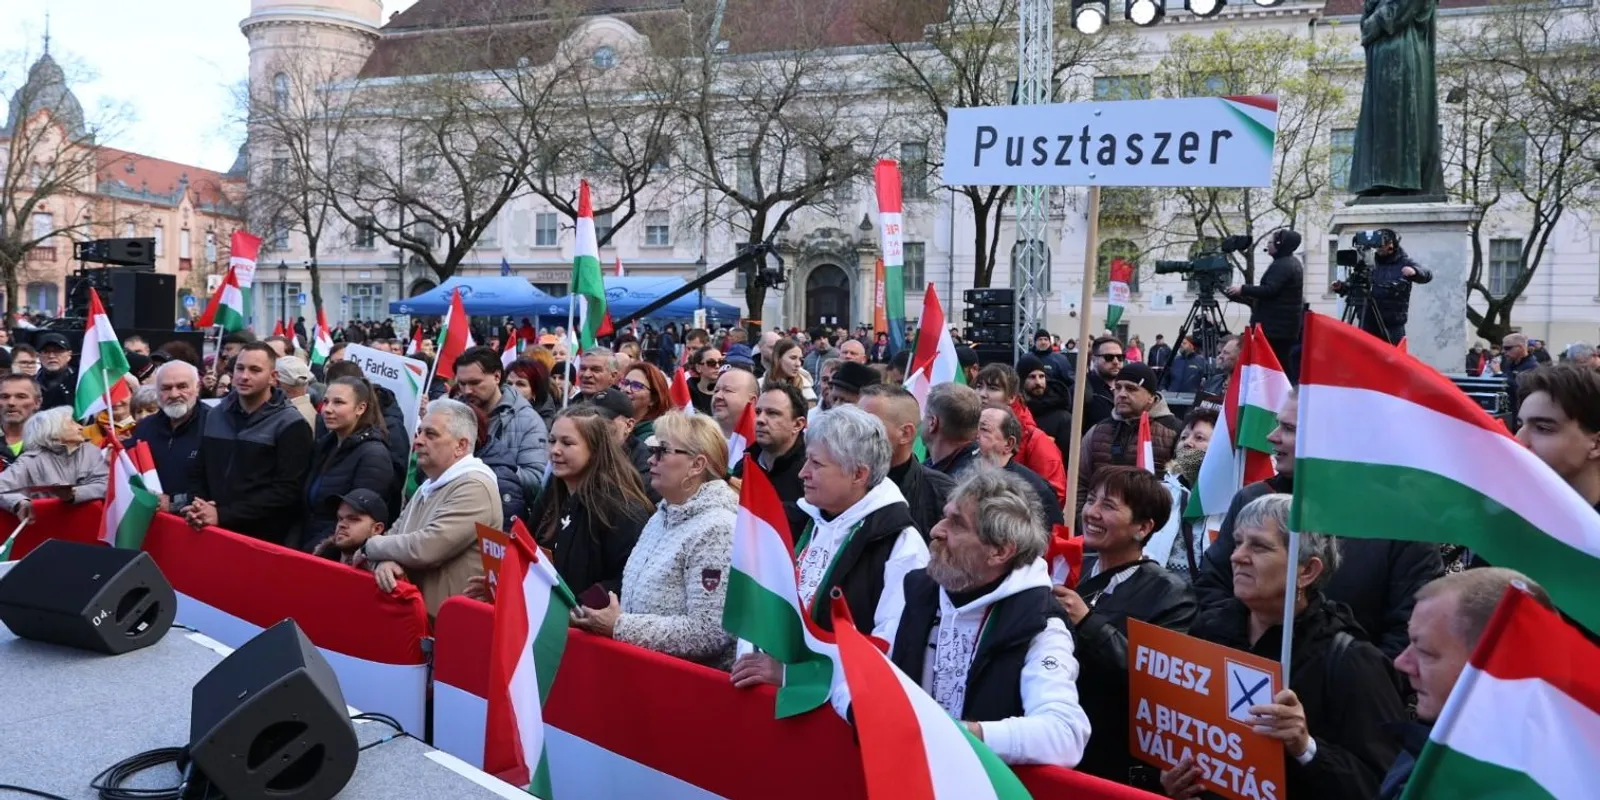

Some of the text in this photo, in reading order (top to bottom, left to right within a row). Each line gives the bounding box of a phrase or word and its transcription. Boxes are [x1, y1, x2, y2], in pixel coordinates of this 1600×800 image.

[973, 125, 1233, 167] Pusztaszer
[365, 357, 399, 380] Farkas
[92, 609, 112, 627] 04.
[1135, 645, 1211, 696] FIDESZ
[1135, 697, 1244, 761] A BIZTOS
[1136, 726, 1277, 800] VÁLASZTÁS
